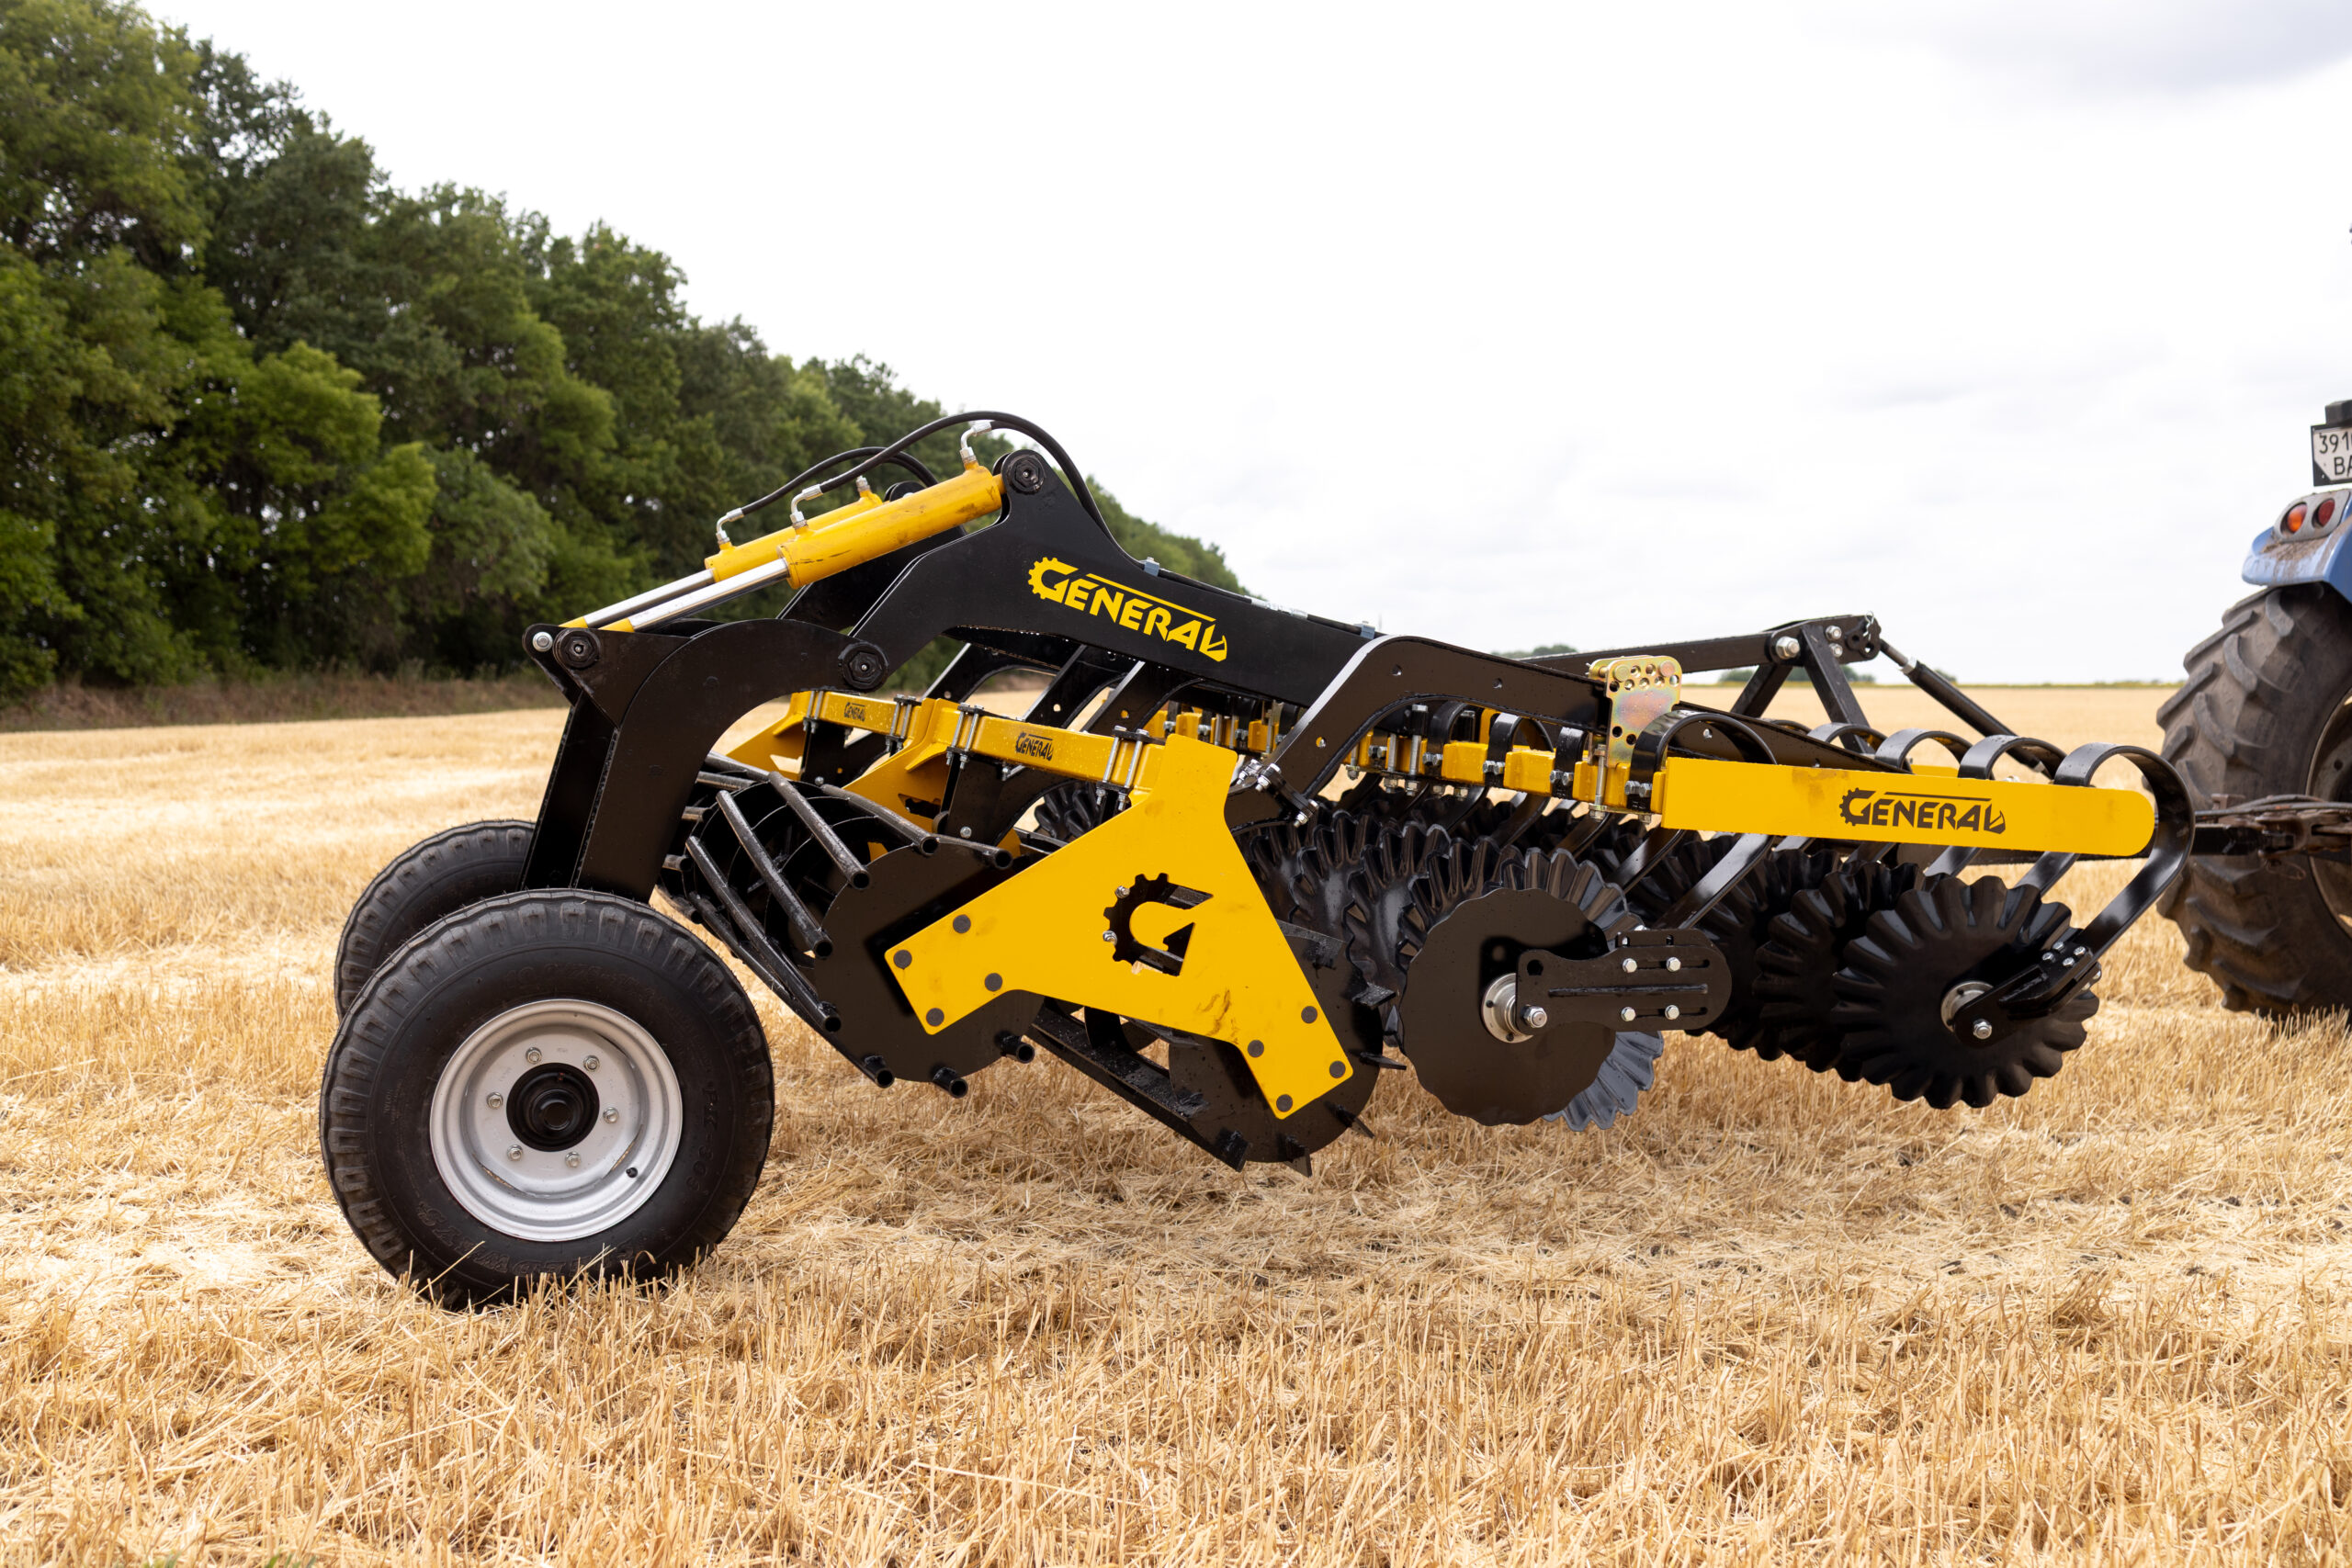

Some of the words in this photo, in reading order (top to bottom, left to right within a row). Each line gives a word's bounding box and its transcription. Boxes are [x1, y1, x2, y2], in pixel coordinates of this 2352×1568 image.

[2319, 431, 2352, 454] 391
[1027, 557, 1227, 662] GENERAL
[844, 702, 865, 722] GENERAL
[1015, 731, 1054, 761] GENERAL
[1839, 787, 2006, 834] GENERAL
